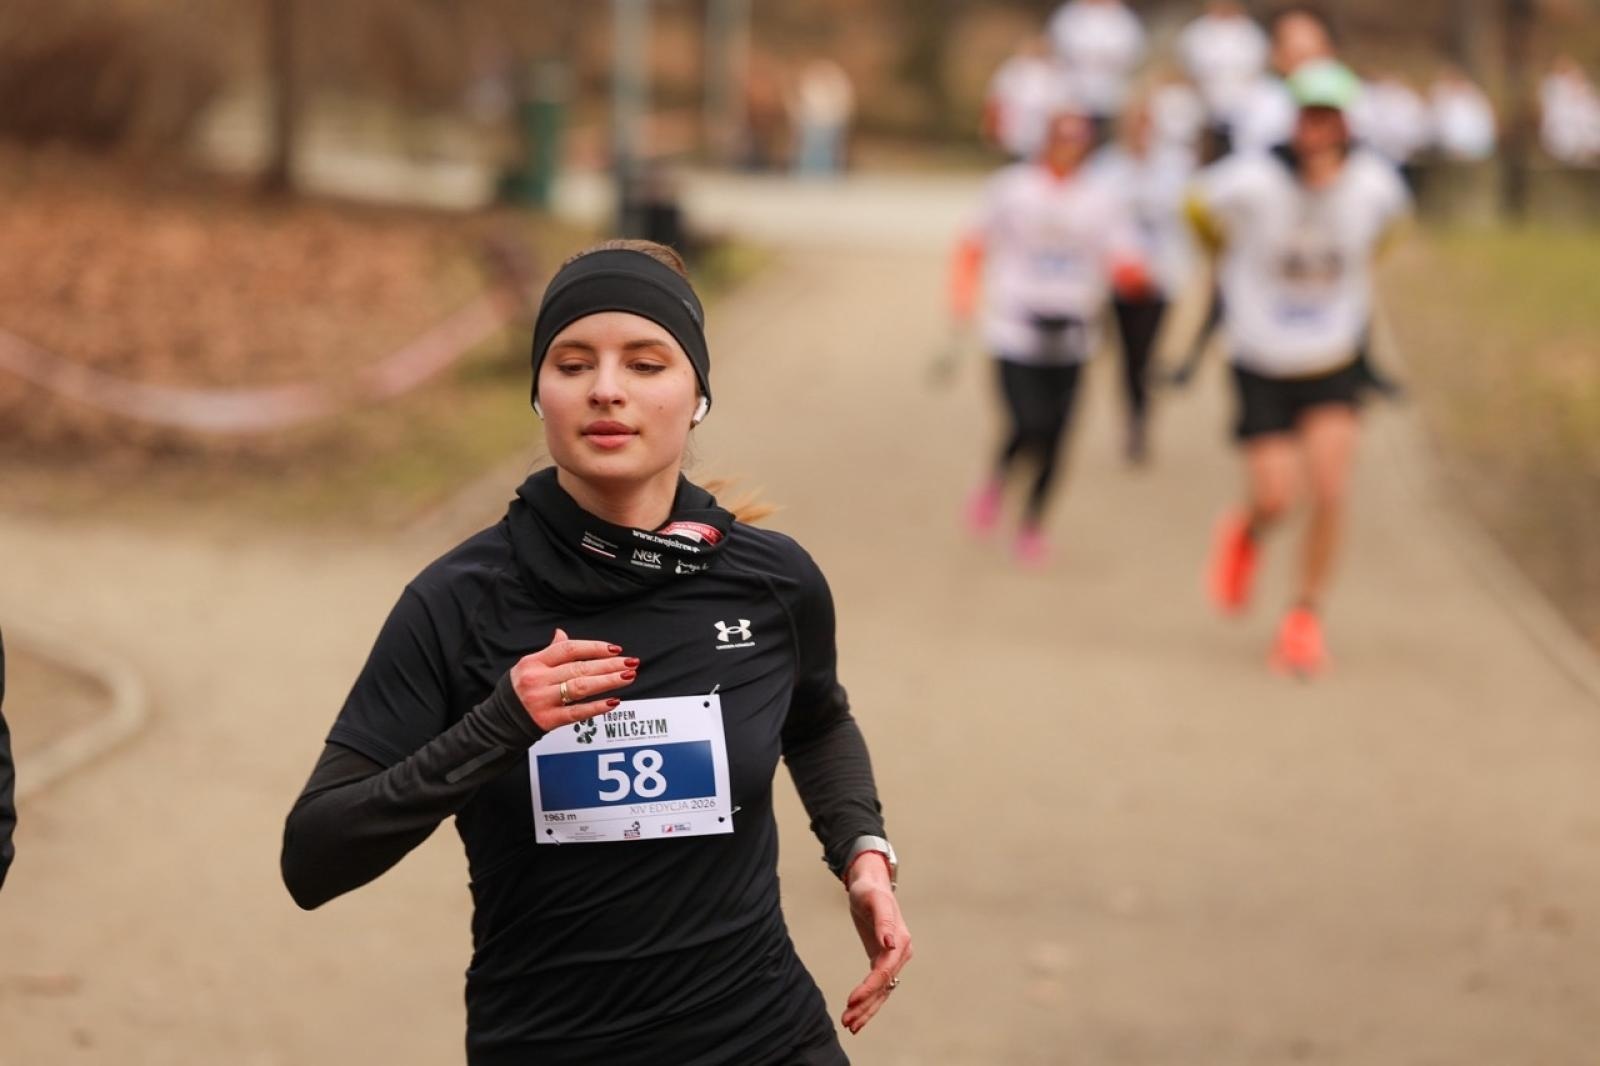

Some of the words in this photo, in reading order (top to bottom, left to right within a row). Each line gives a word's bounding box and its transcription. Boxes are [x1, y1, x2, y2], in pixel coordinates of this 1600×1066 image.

[604, 718, 668, 739] WILCZYM
[597, 749, 667, 802] 58
[649, 801, 689, 813] EDYCJA
[691, 799, 716, 809] 2026
[544, 813, 565, 821] 1963
